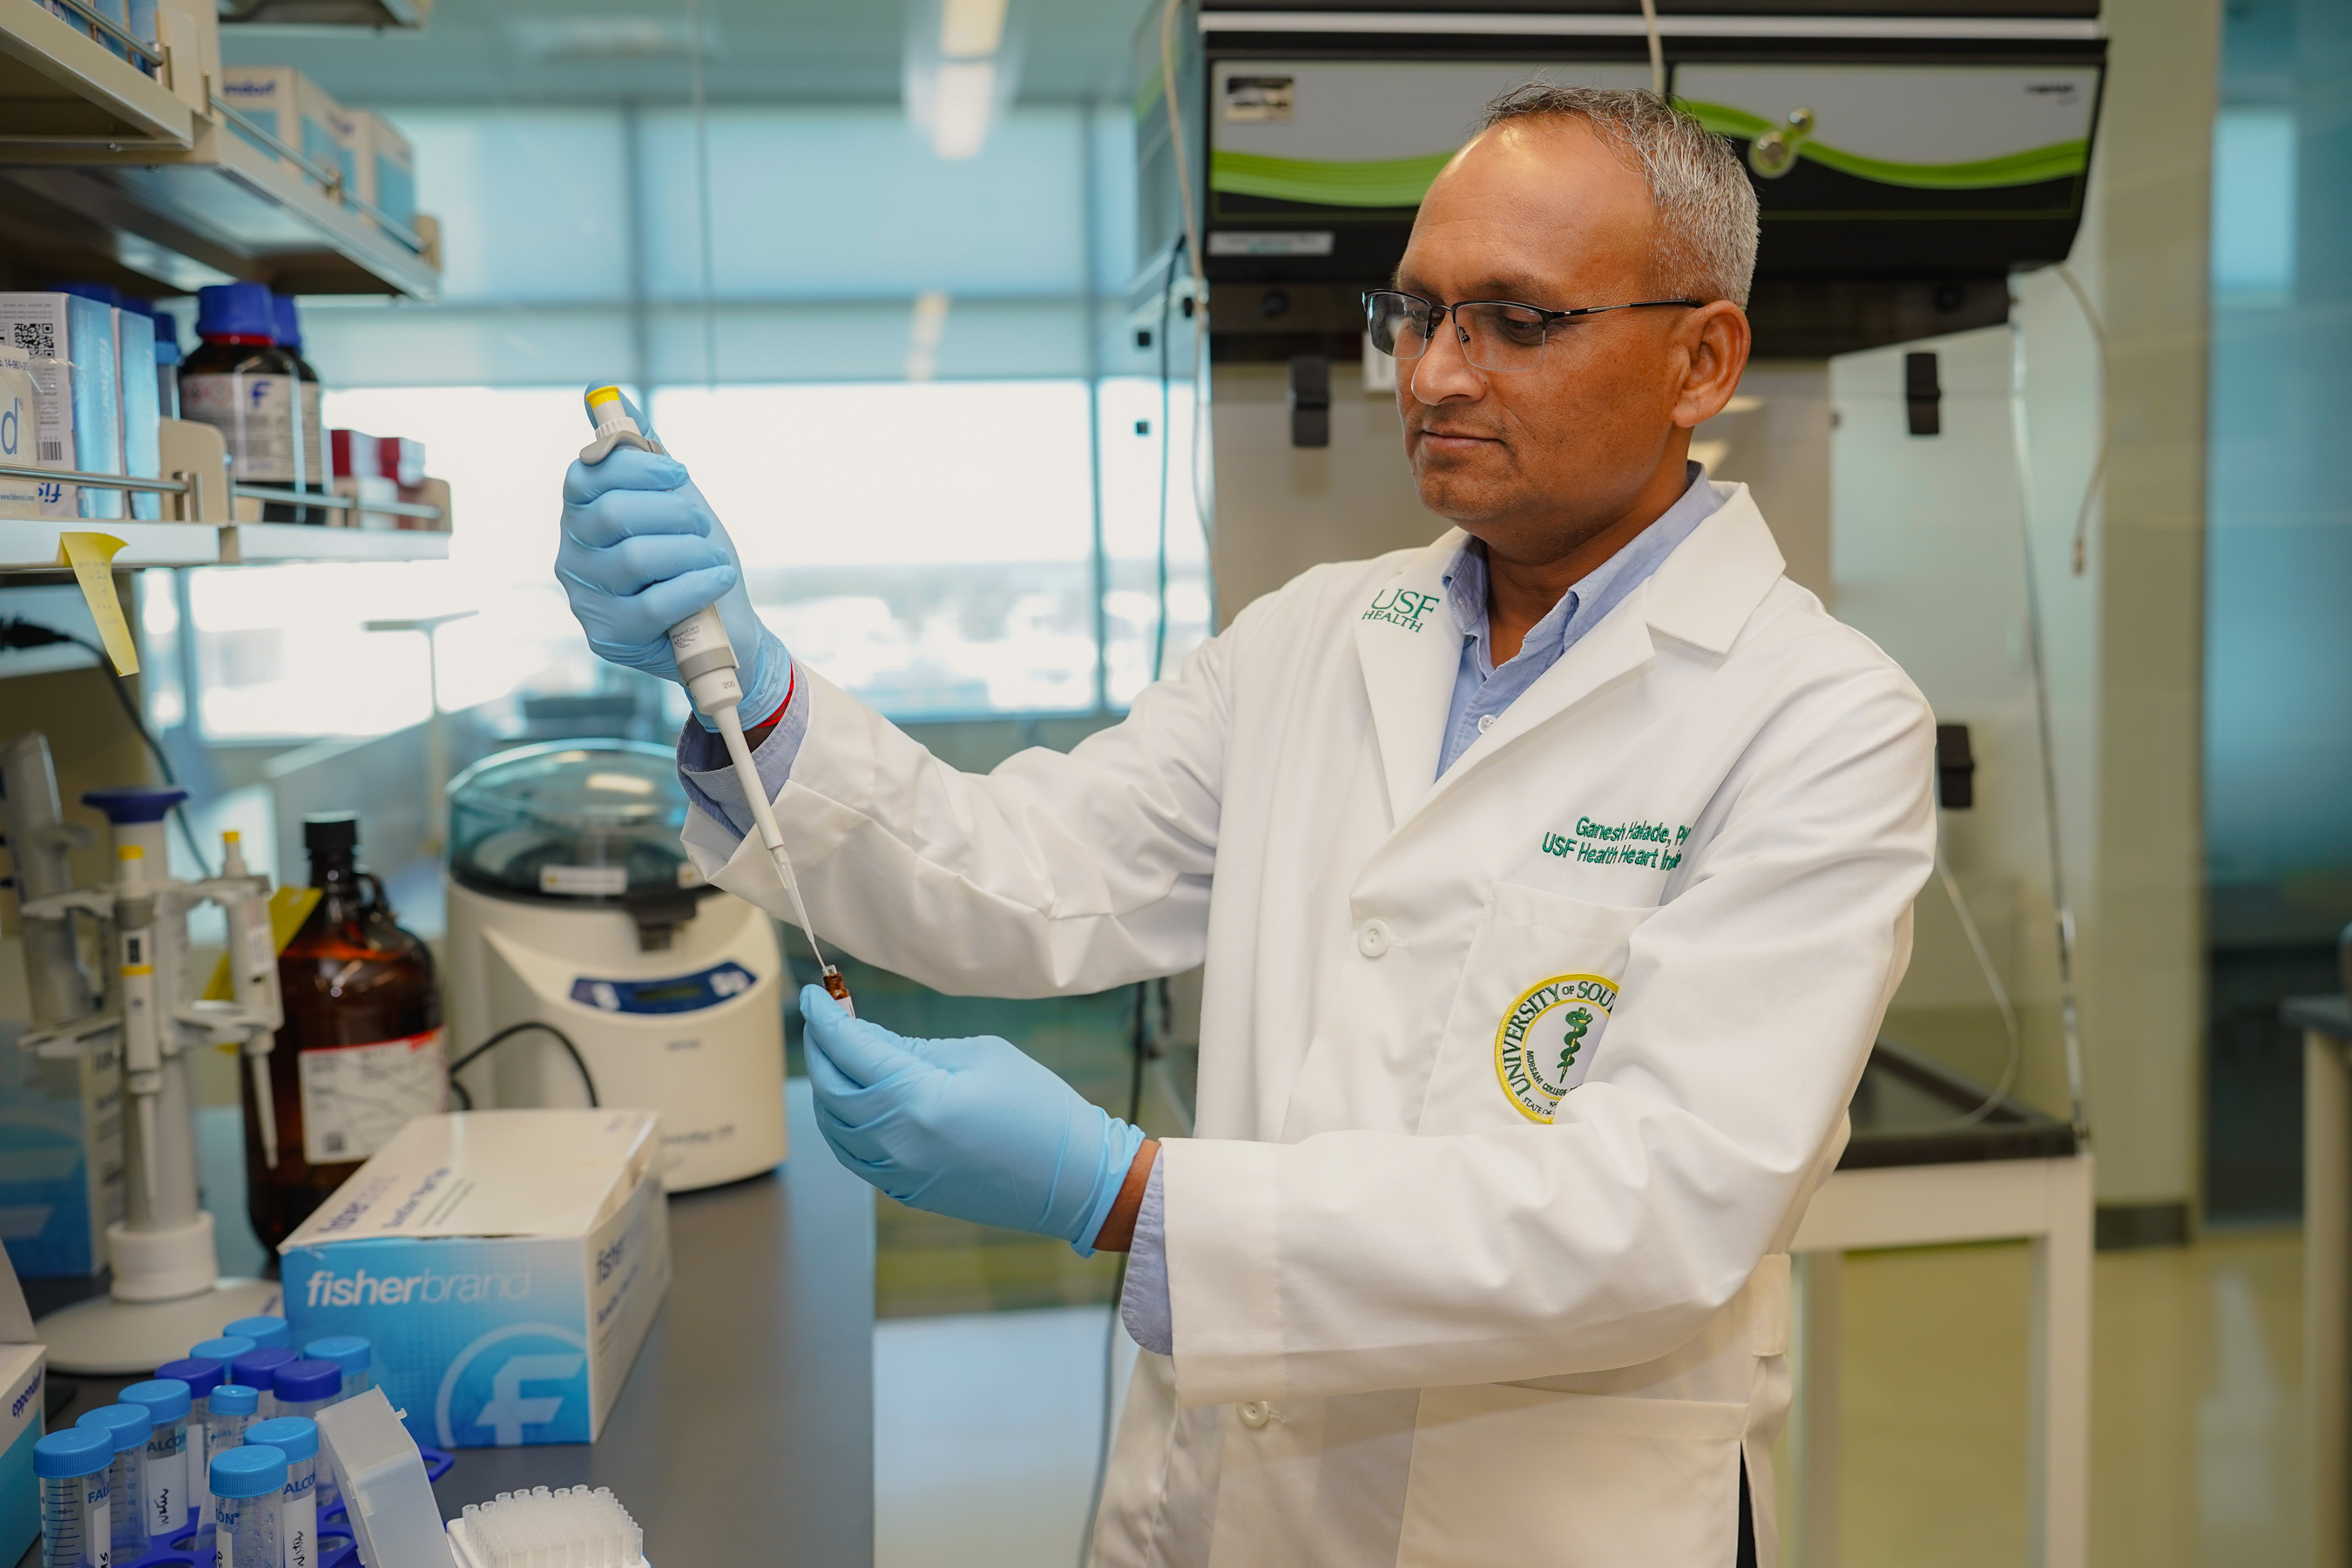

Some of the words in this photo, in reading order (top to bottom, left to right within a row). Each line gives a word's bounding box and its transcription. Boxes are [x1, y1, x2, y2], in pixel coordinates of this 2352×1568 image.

[1370, 588, 1441, 620] USF
[1361, 610, 1424, 633] HEALTH
[722, 680, 736, 690] 200
[1576, 816, 1625, 841] Ganesh
[1625, 820, 1672, 848] Halade,
[1542, 831, 1578, 858] USF
[1577, 841, 1619, 864] Health
[1618, 844, 1659, 868] Heart
[1502, 983, 1561, 1098] UNIVERSITY
[1526, 1050, 1544, 1085] MORSANI
[1542, 1082, 1568, 1097] COLLEGE
[1522, 1096, 1543, 1114] STATE
[306, 1267, 533, 1307] fisherbrand
